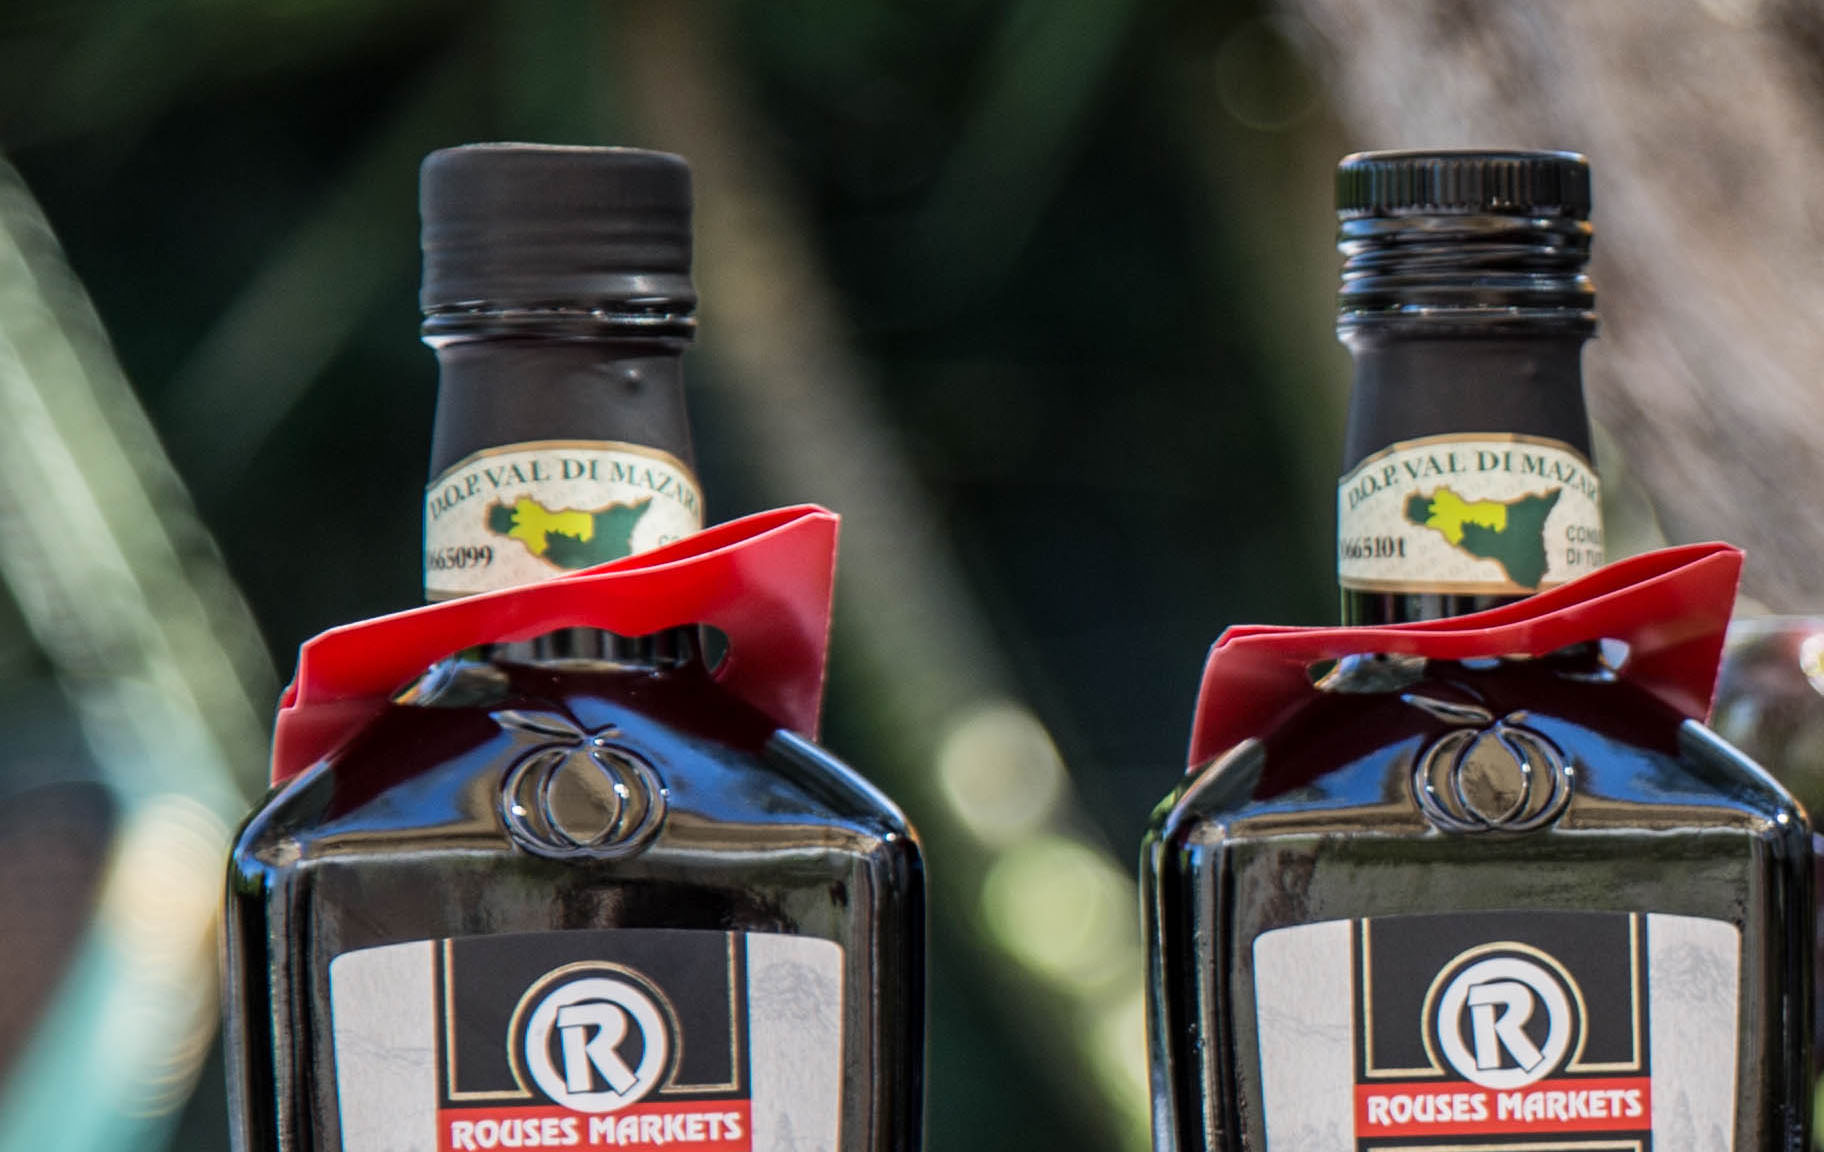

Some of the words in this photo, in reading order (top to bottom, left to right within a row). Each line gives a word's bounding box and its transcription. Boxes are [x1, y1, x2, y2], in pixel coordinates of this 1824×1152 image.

[483, 460, 550, 491] VAL
[560, 458, 598, 481] DI
[611, 460, 699, 518] MAZAR
[1402, 451, 1466, 480] VAL
[1477, 450, 1512, 472] DI
[1522, 452, 1598, 500] MAZAR
[1367, 1092, 1489, 1126] ROUSES
[1497, 1089, 1643, 1122] MARKETS
[450, 1115, 579, 1151] ROUSES
[588, 1111, 743, 1147] MARKETS
